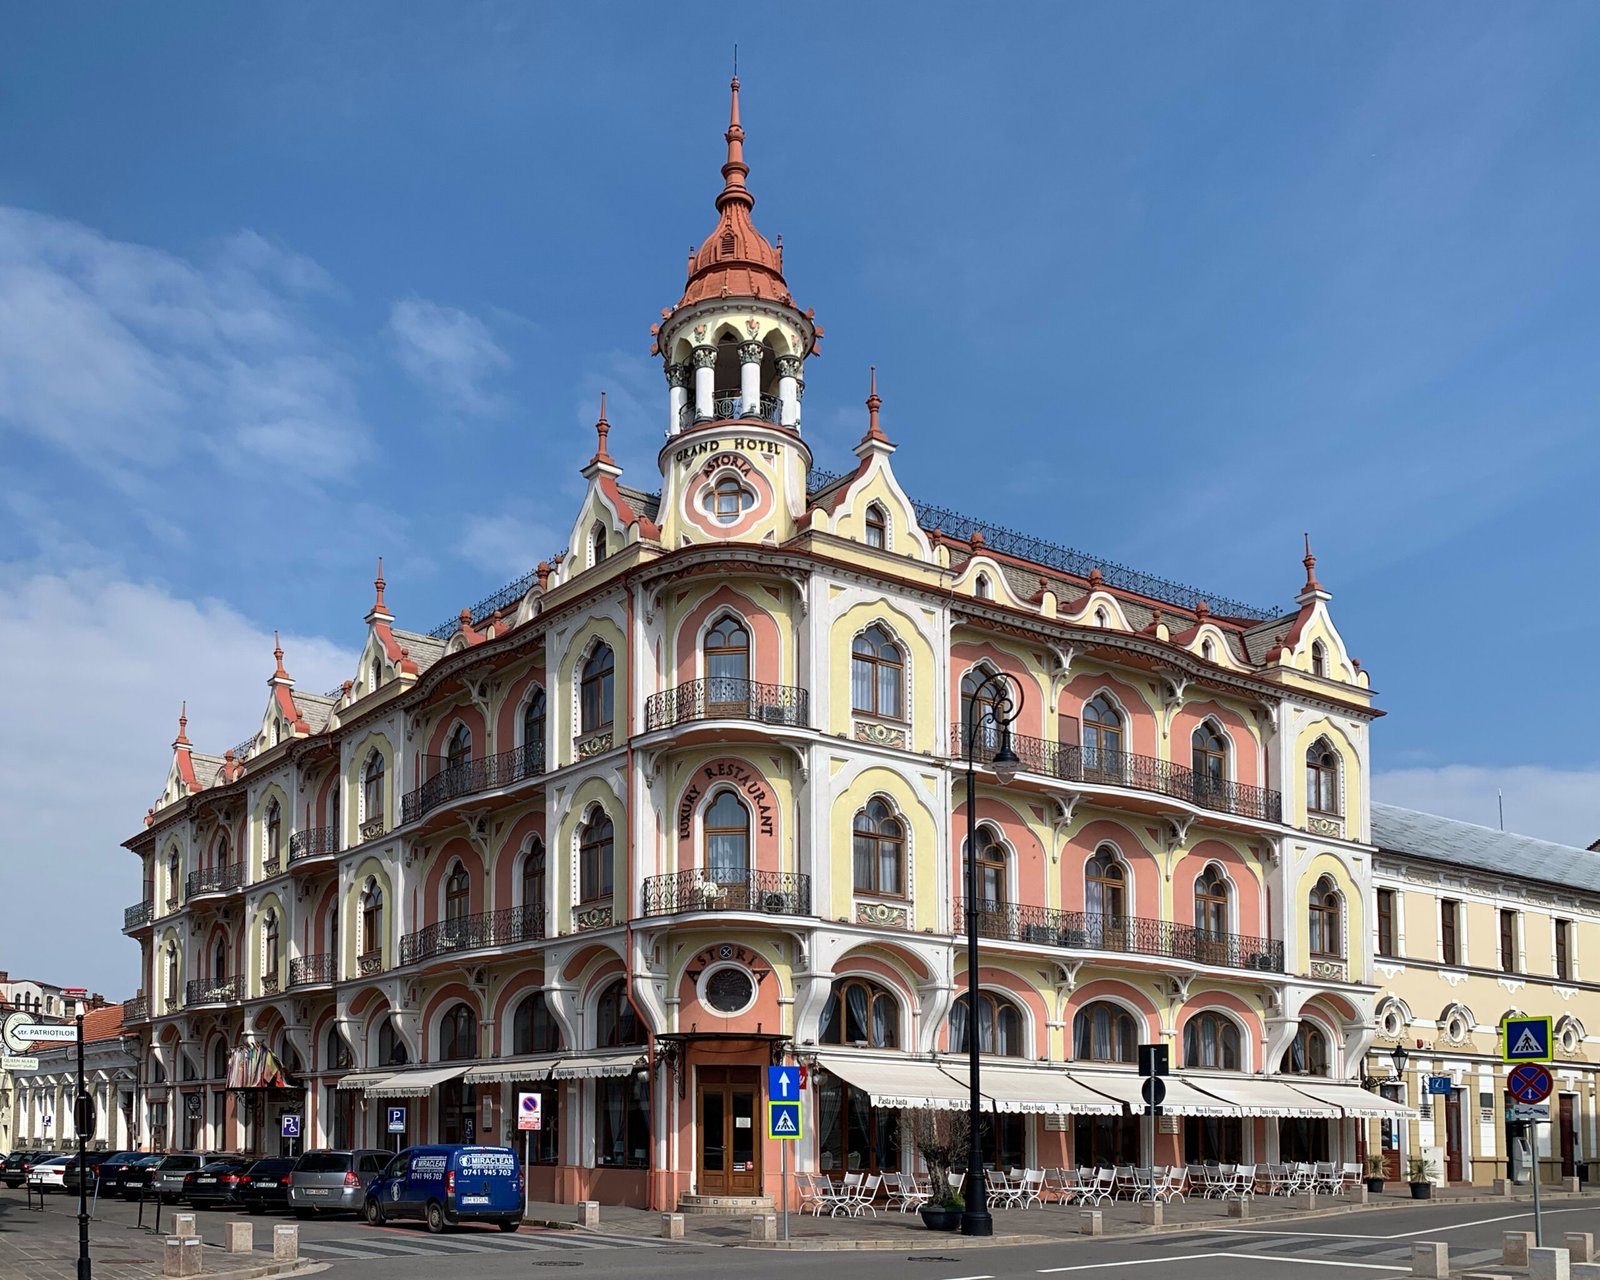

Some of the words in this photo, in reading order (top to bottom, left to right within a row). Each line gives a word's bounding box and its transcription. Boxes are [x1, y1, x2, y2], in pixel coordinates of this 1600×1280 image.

[676, 440, 720, 462] GRAND
[734, 438, 781, 455] HOTEL
[702, 455, 752, 478] ASTORIA
[680, 784, 701, 839] LUXURY
[704, 764, 773, 837] RESTAURANT
[284, 1118, 293, 1128] P
[394, 1111, 400, 1120] P
